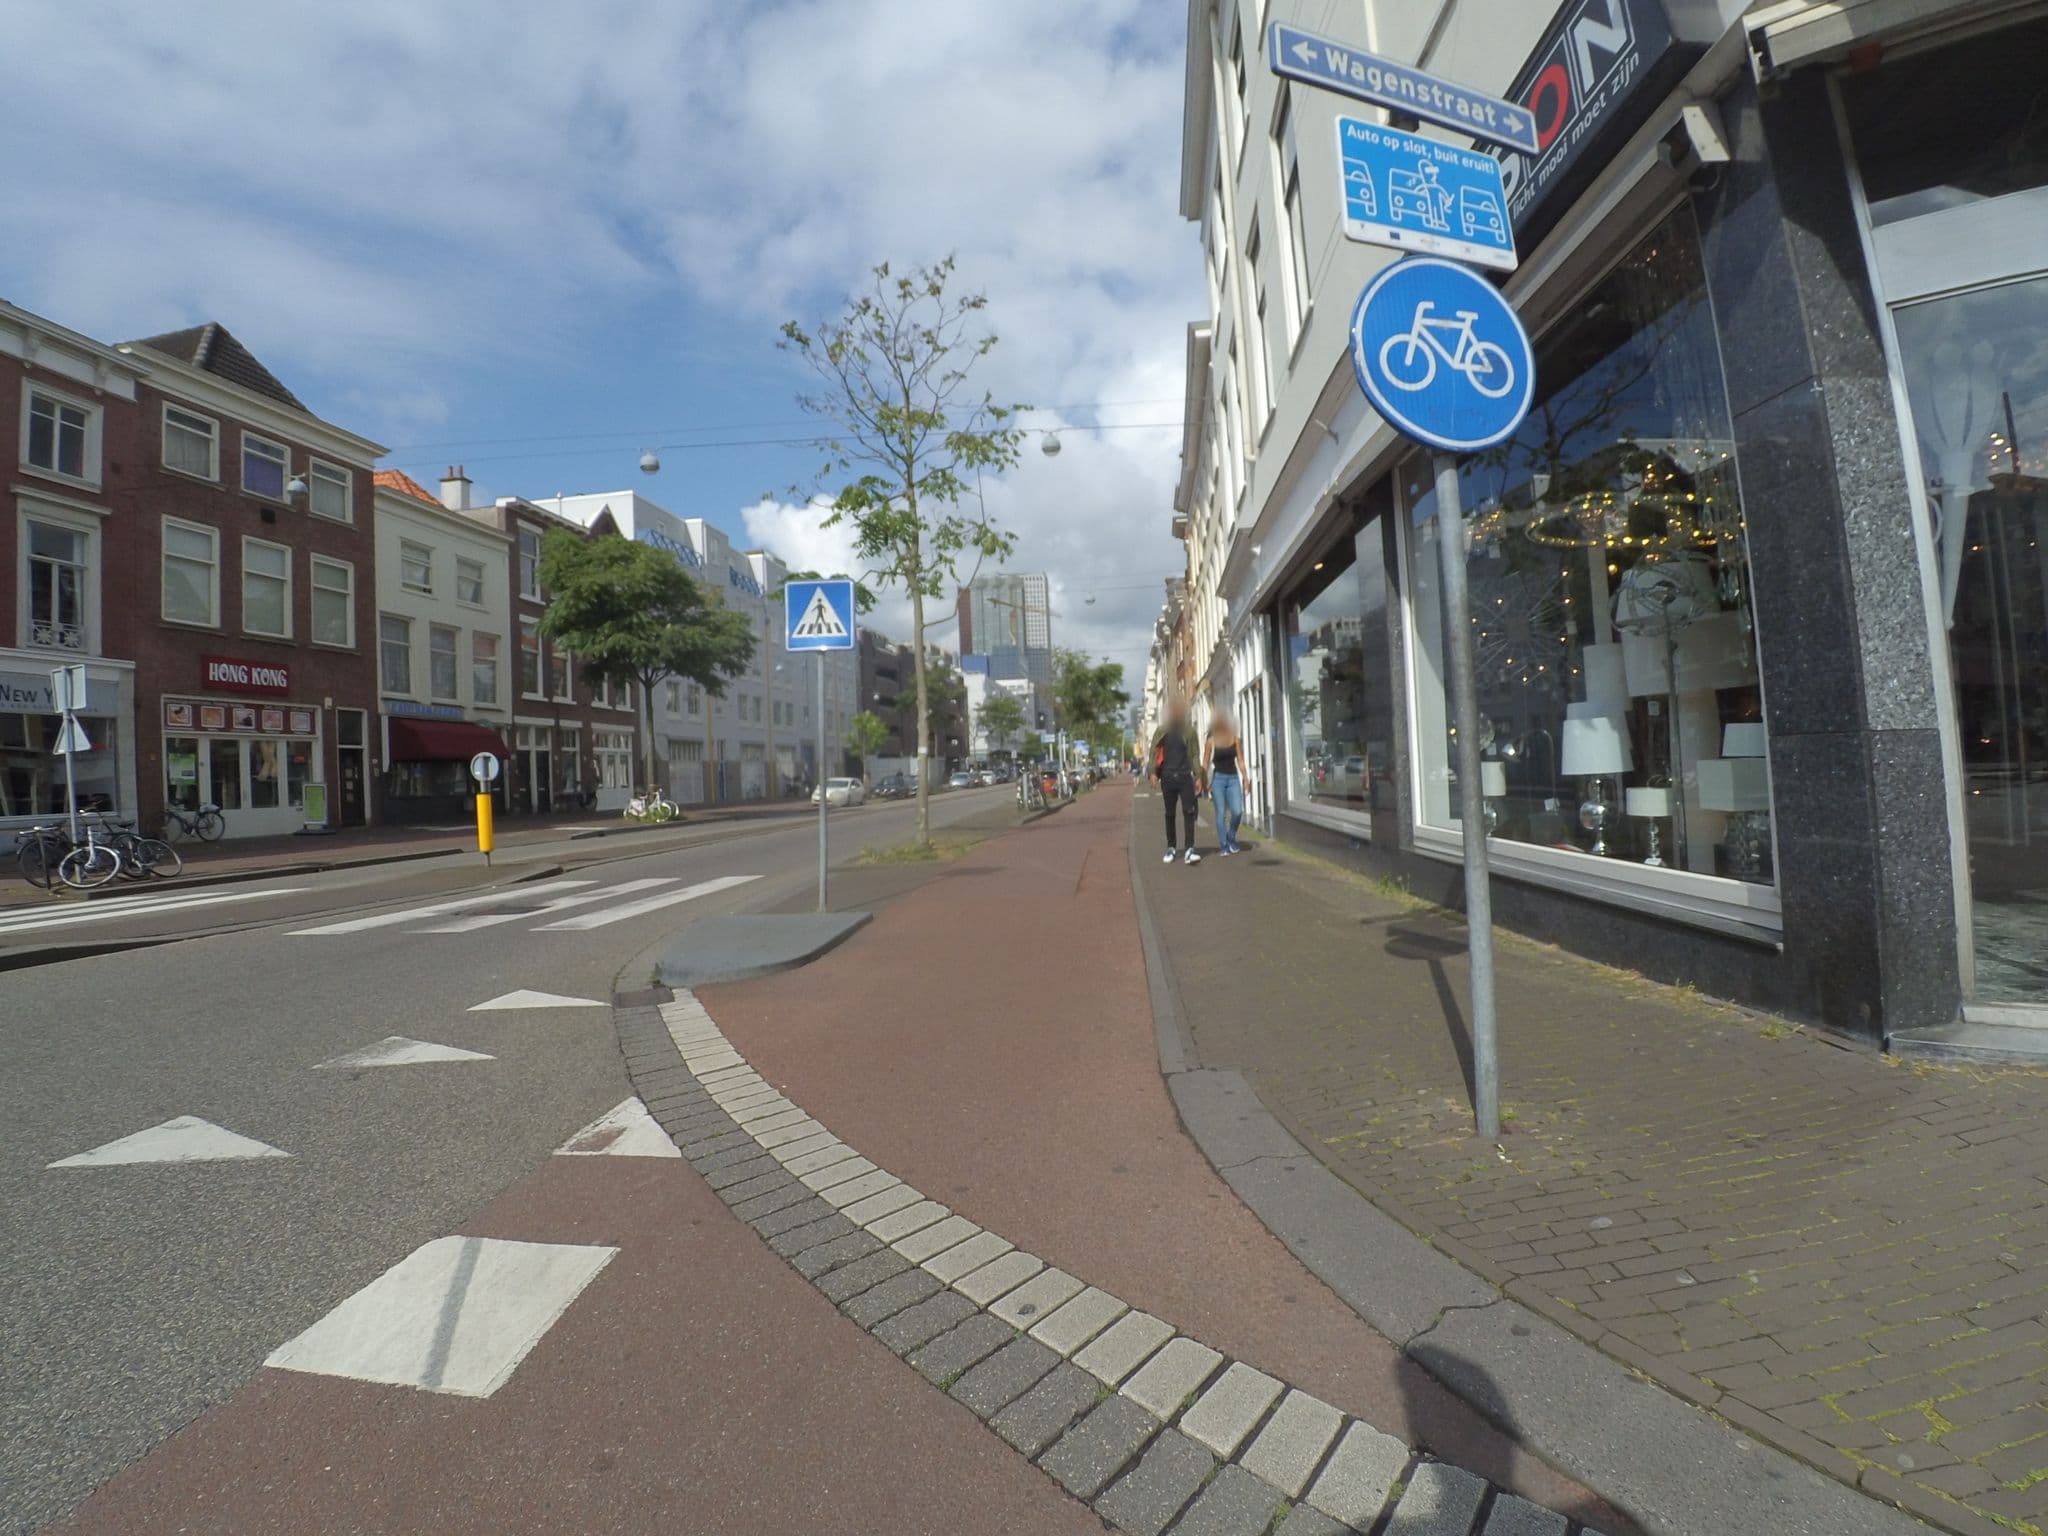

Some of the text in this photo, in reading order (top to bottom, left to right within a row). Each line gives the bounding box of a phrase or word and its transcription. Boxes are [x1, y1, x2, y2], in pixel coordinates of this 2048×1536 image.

[1324, 46, 1497, 127] Wagenstraat
[1347, 124, 1495, 174] Auto op slot, buit eruit!
[1512, 51, 1640, 219] licht mooi moet zijn
[208, 662, 288, 688] HONG KONG
